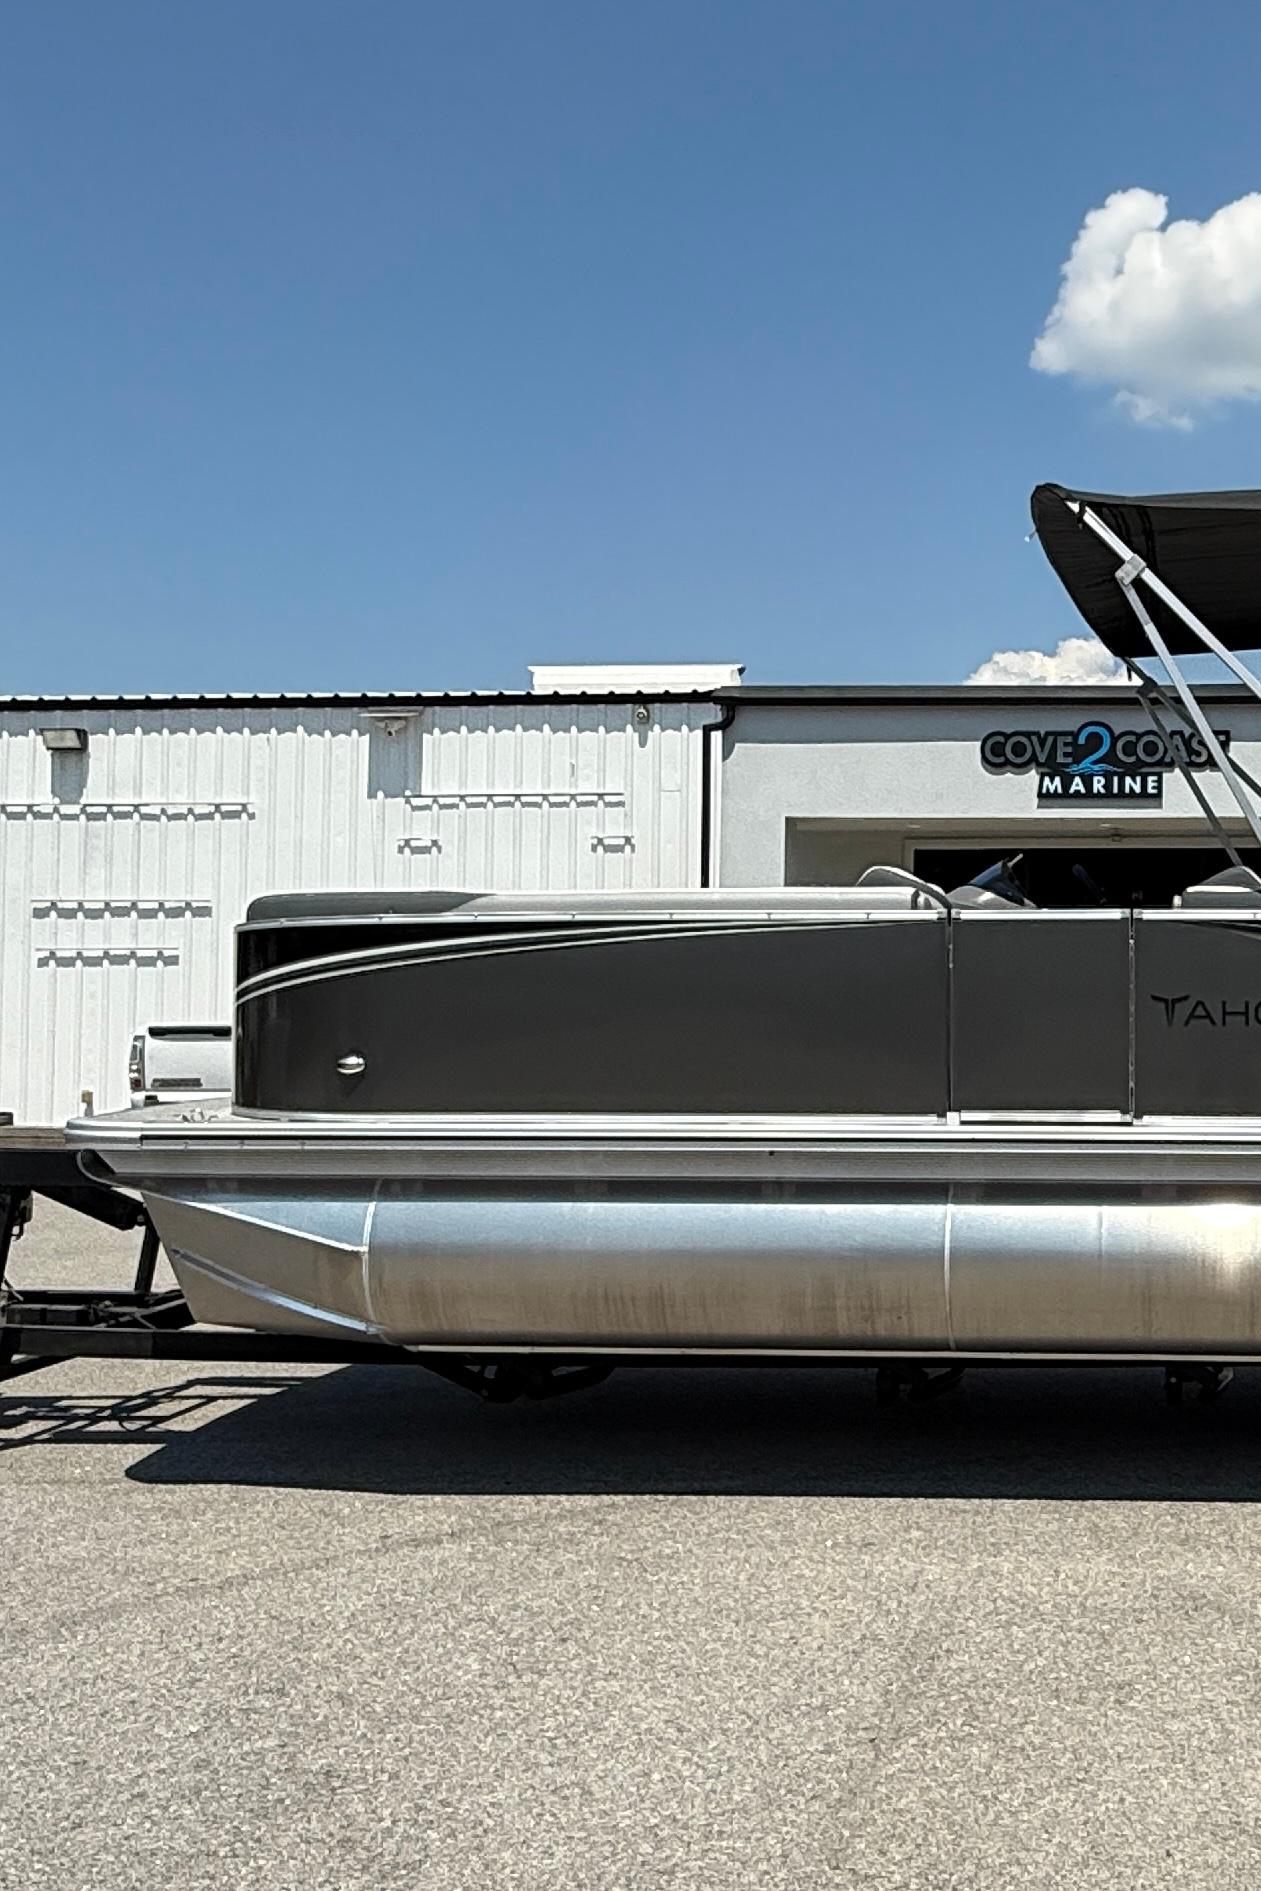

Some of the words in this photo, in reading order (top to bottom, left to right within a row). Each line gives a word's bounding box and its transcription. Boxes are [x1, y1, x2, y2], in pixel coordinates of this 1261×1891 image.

[984, 735, 1074, 763] COVE
[1077, 725, 1112, 767] 2
[1115, 734, 1226, 763] COAS
[1041, 775, 1159, 794] MARINE
